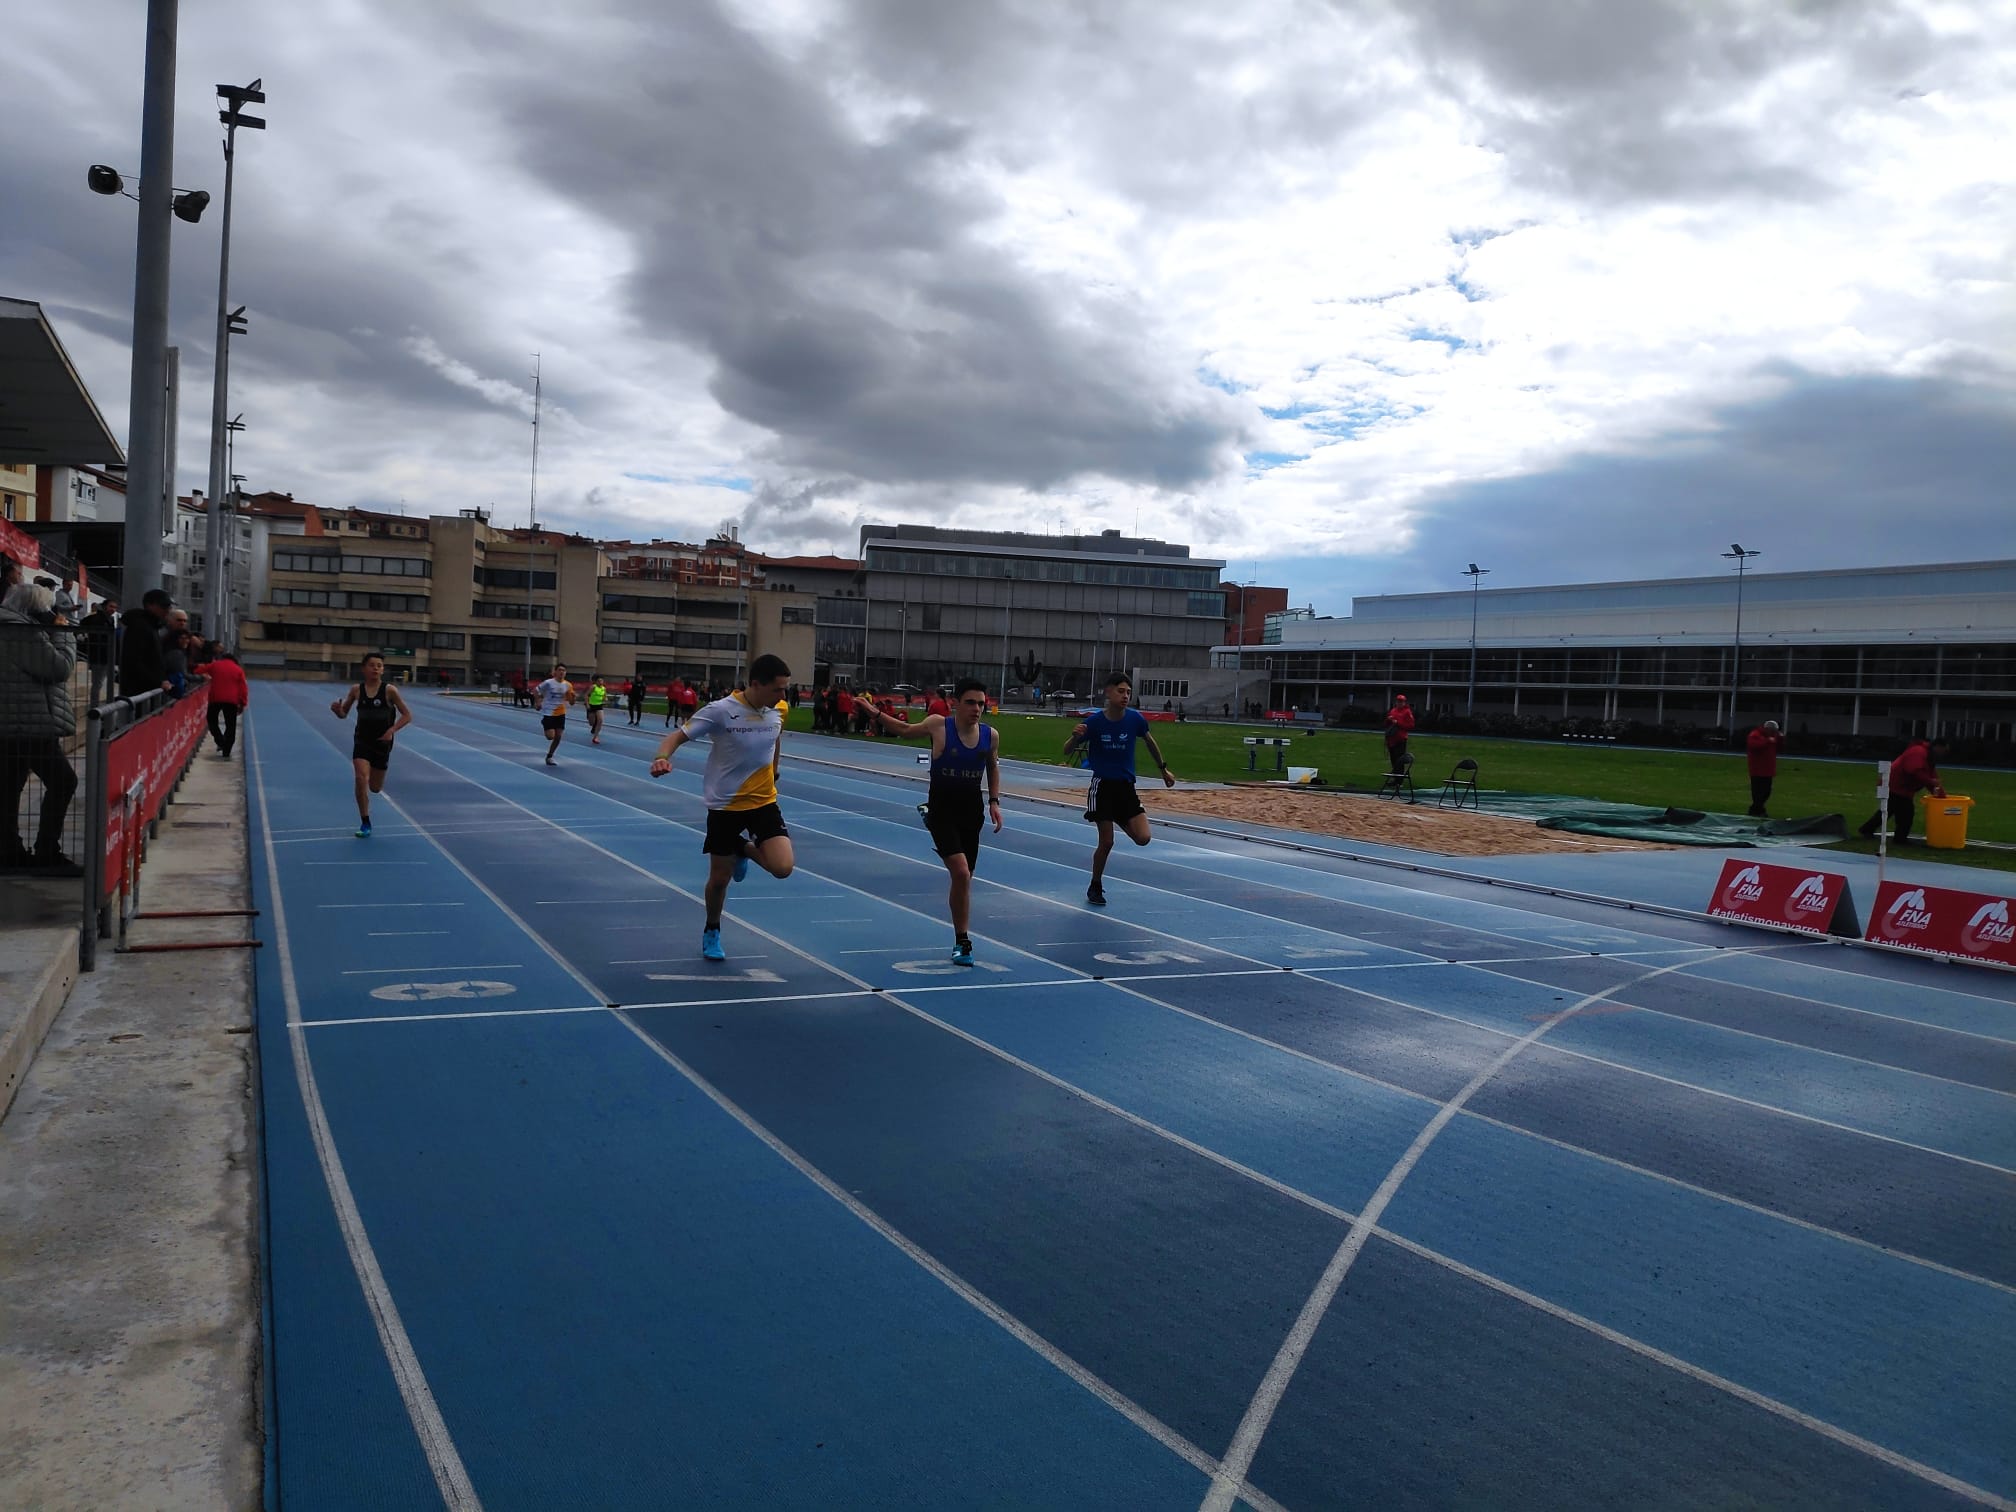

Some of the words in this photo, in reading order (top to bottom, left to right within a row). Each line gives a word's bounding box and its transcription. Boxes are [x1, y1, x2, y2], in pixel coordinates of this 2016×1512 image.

[1738, 883, 1764, 898] FNA
[1801, 894, 1829, 908] FNA
[1899, 909, 1933, 925] FNA
[1896, 920, 1928, 930] ATLETISMO
[1981, 922, 2016, 938] FNA
[369, 980, 518, 1001] 8
